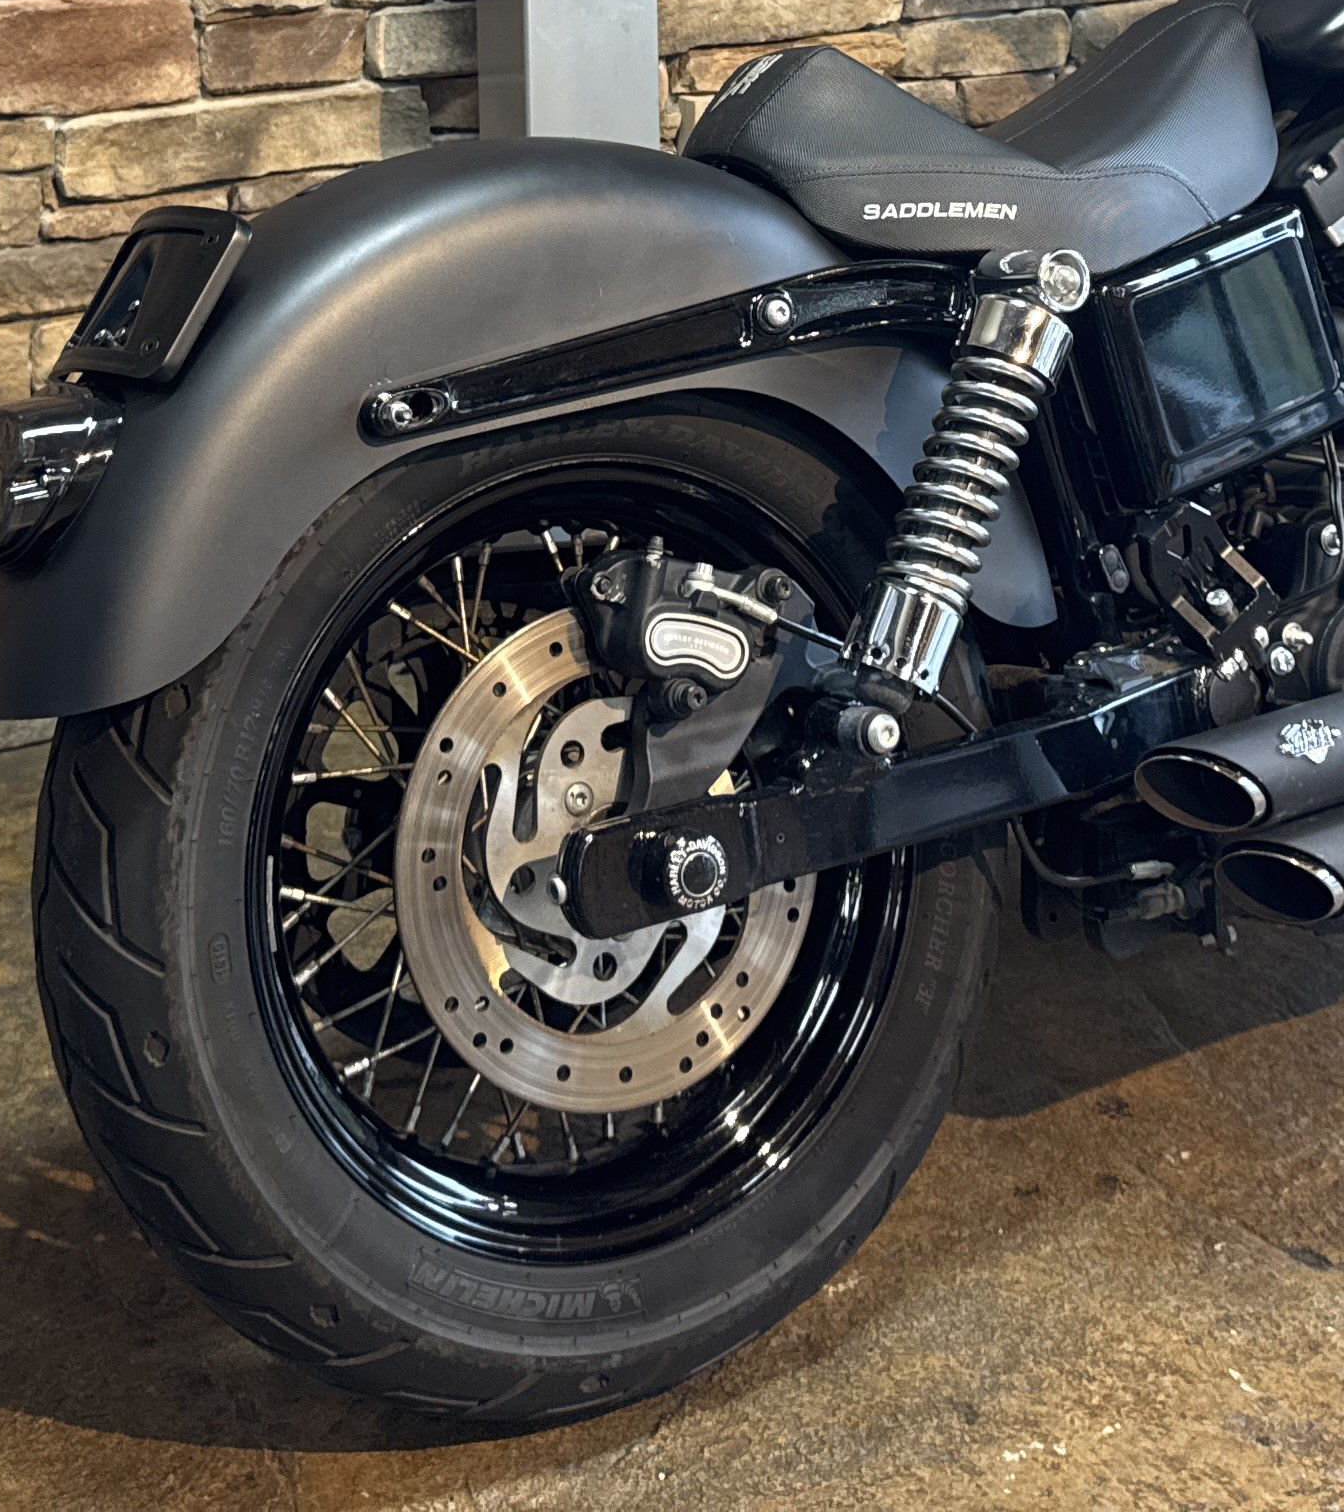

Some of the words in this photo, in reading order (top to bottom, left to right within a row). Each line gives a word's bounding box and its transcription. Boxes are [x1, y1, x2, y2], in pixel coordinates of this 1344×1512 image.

[862, 181, 1018, 220] SADDLEMEN
[677, 894, 714, 910] MOTOR
[924, 840, 957, 972] CORCHER
[410, 1259, 598, 1320] MICHELIN
